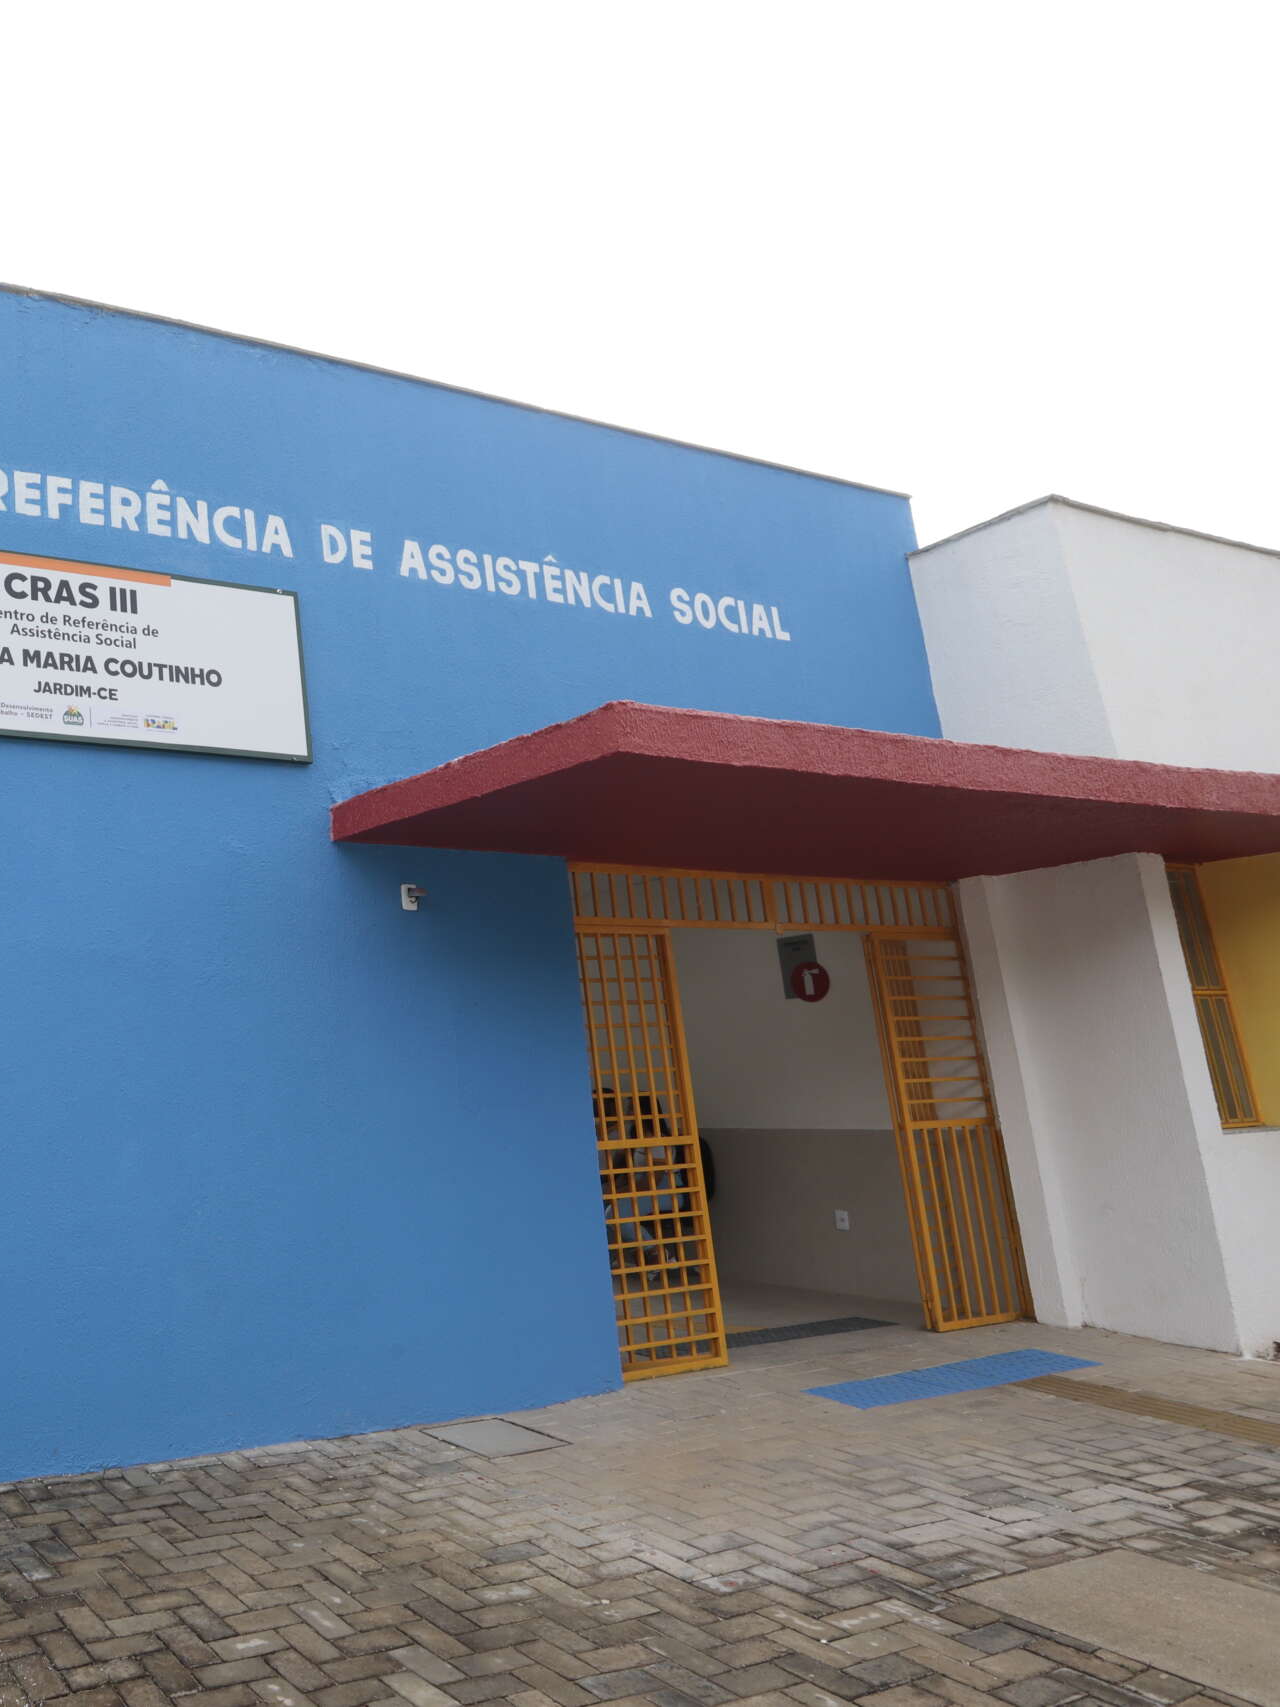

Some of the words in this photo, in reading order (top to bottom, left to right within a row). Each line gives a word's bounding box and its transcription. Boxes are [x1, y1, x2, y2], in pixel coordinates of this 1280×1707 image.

[3, 572, 100, 609] CRAS
[108, 586, 138, 615] III
[319, 522, 375, 571] DE
[399, 539, 654, 618] ASSISTÊNCIA
[669, 587, 792, 641] SOCIAL
[10, 623, 91, 644] Assistência
[95, 634, 138, 649] Social
[39, 611, 58, 626] de
[62, 614, 139, 635] Referência
[142, 625, 160, 638] de
[22, 648, 98, 675] MARIA
[103, 657, 223, 688] COUTINHO
[33, 680, 119, 701] JARDIM-CE
[0, 702, 53, 713] Desenvolvimento
